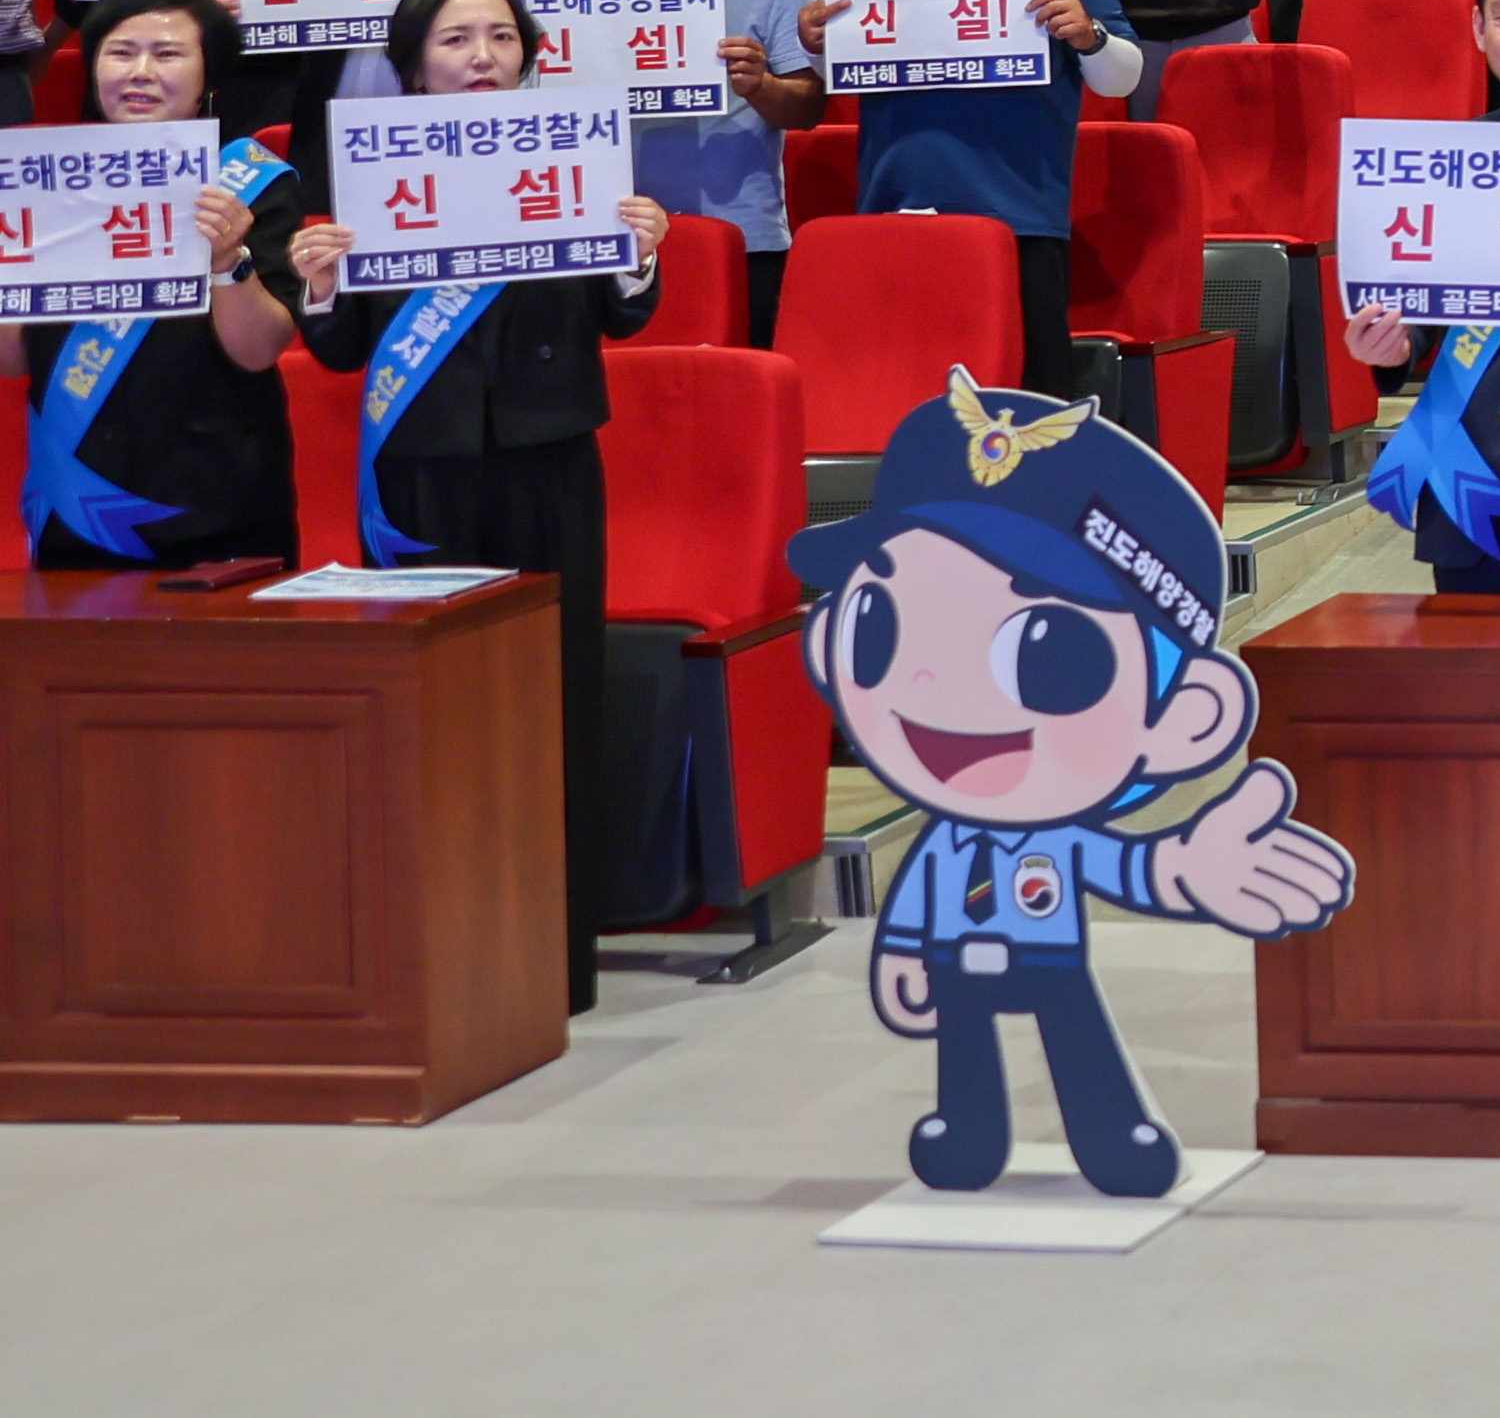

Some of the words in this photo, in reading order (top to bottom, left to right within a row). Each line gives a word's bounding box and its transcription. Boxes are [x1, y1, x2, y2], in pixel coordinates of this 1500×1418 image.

[306, 19, 389, 43] 골든타임
[859, 0, 897, 45] 신
[627, 24, 686, 71] 설!
[840, 63, 898, 86] 서남해
[905, 59, 984, 83] 골든타임
[994, 58, 1037, 79] 확보
[344, 108, 620, 164] 진도해양경찰서
[384, 174, 438, 231] 신
[508, 165, 584, 222] 설!
[101, 202, 173, 259] 설!
[1383, 204, 1434, 262] 신
[358, 252, 439, 281] 서남해
[450, 243, 555, 275] 골든타임
[568, 239, 621, 265] 확보
[44, 282, 143, 312] 골든타임
[155, 281, 198, 306] 확보
[1083, 508, 1216, 648] 진도해양경찰
